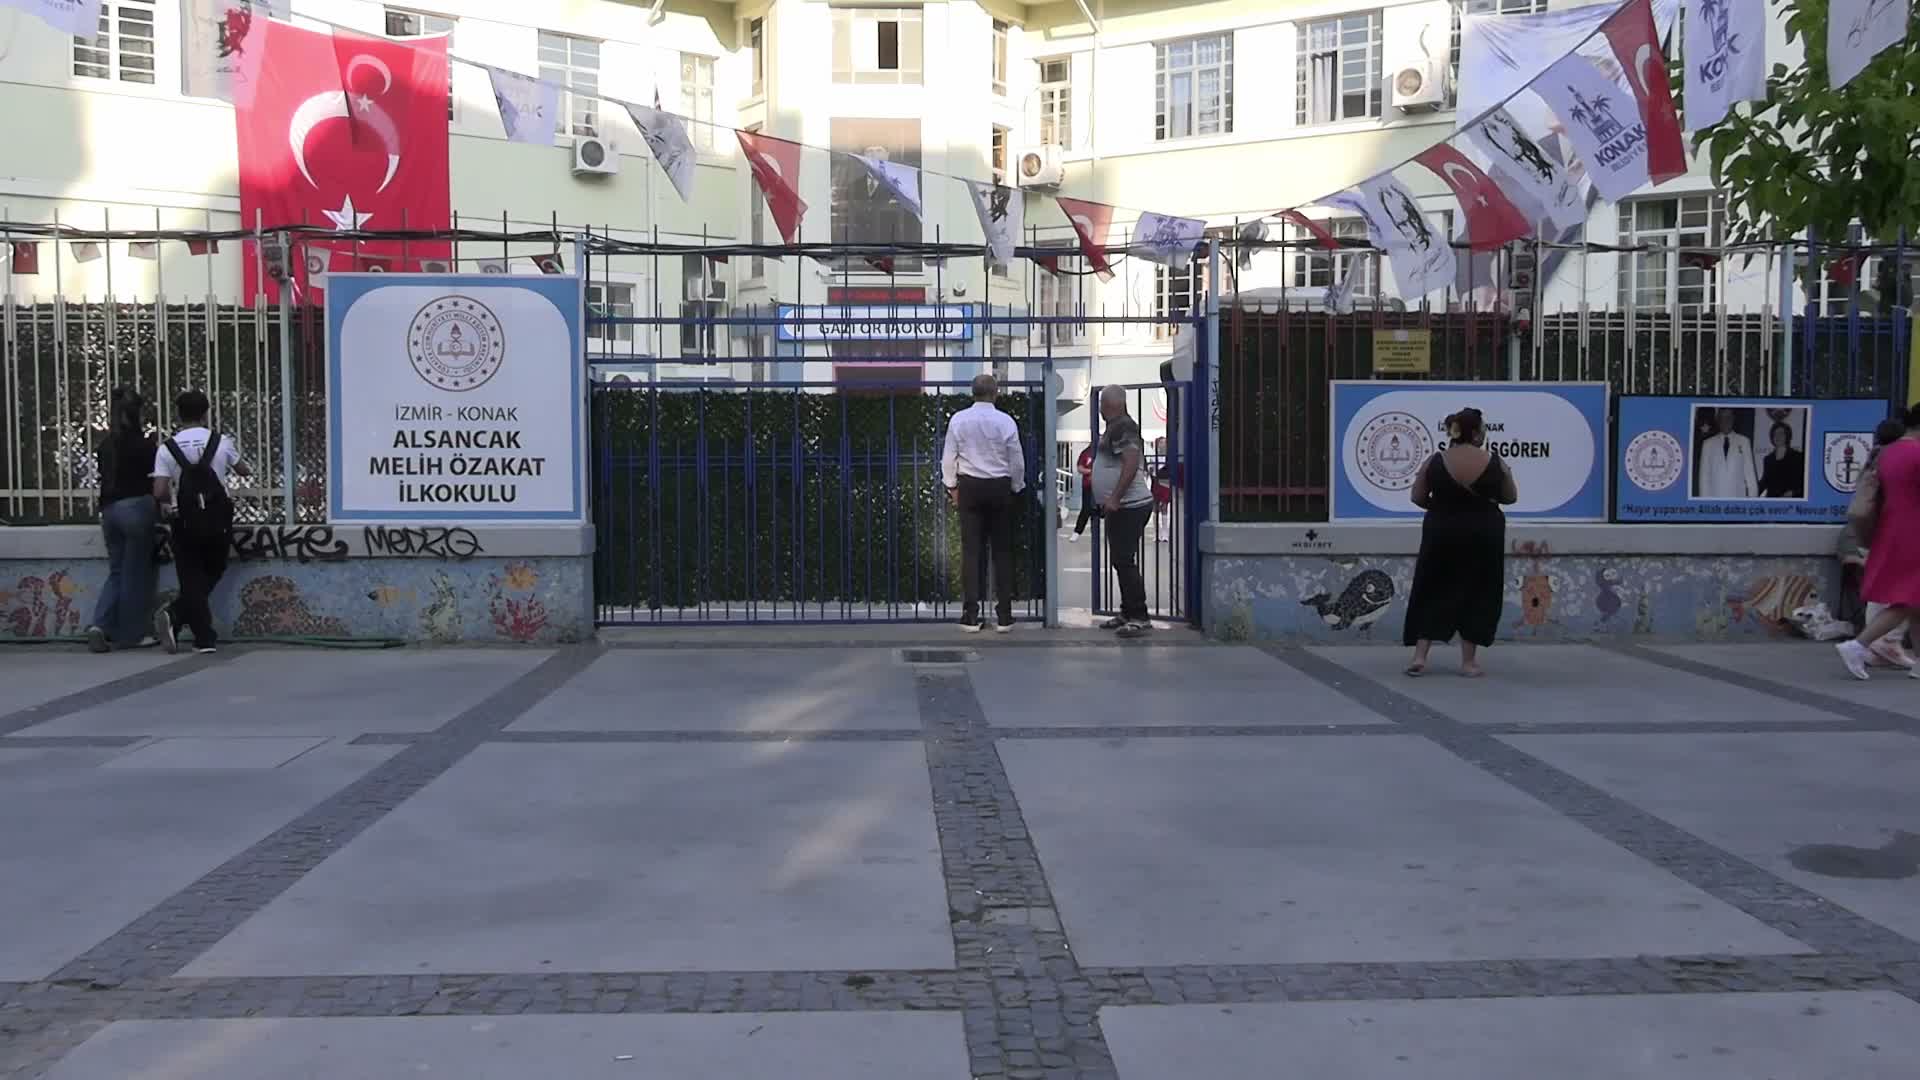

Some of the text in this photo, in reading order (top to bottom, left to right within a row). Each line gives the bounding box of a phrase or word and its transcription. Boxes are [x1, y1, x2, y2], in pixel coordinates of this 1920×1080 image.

[1594, 123, 1647, 168] KONAK
[395, 405, 442, 421] İZMİR
[457, 406, 518, 421] KONAK
[393, 430, 521, 449] ALSANCAK
[369, 453, 545, 476] MELİH ÖZAKAT
[399, 480, 516, 502] İLKOKULU
